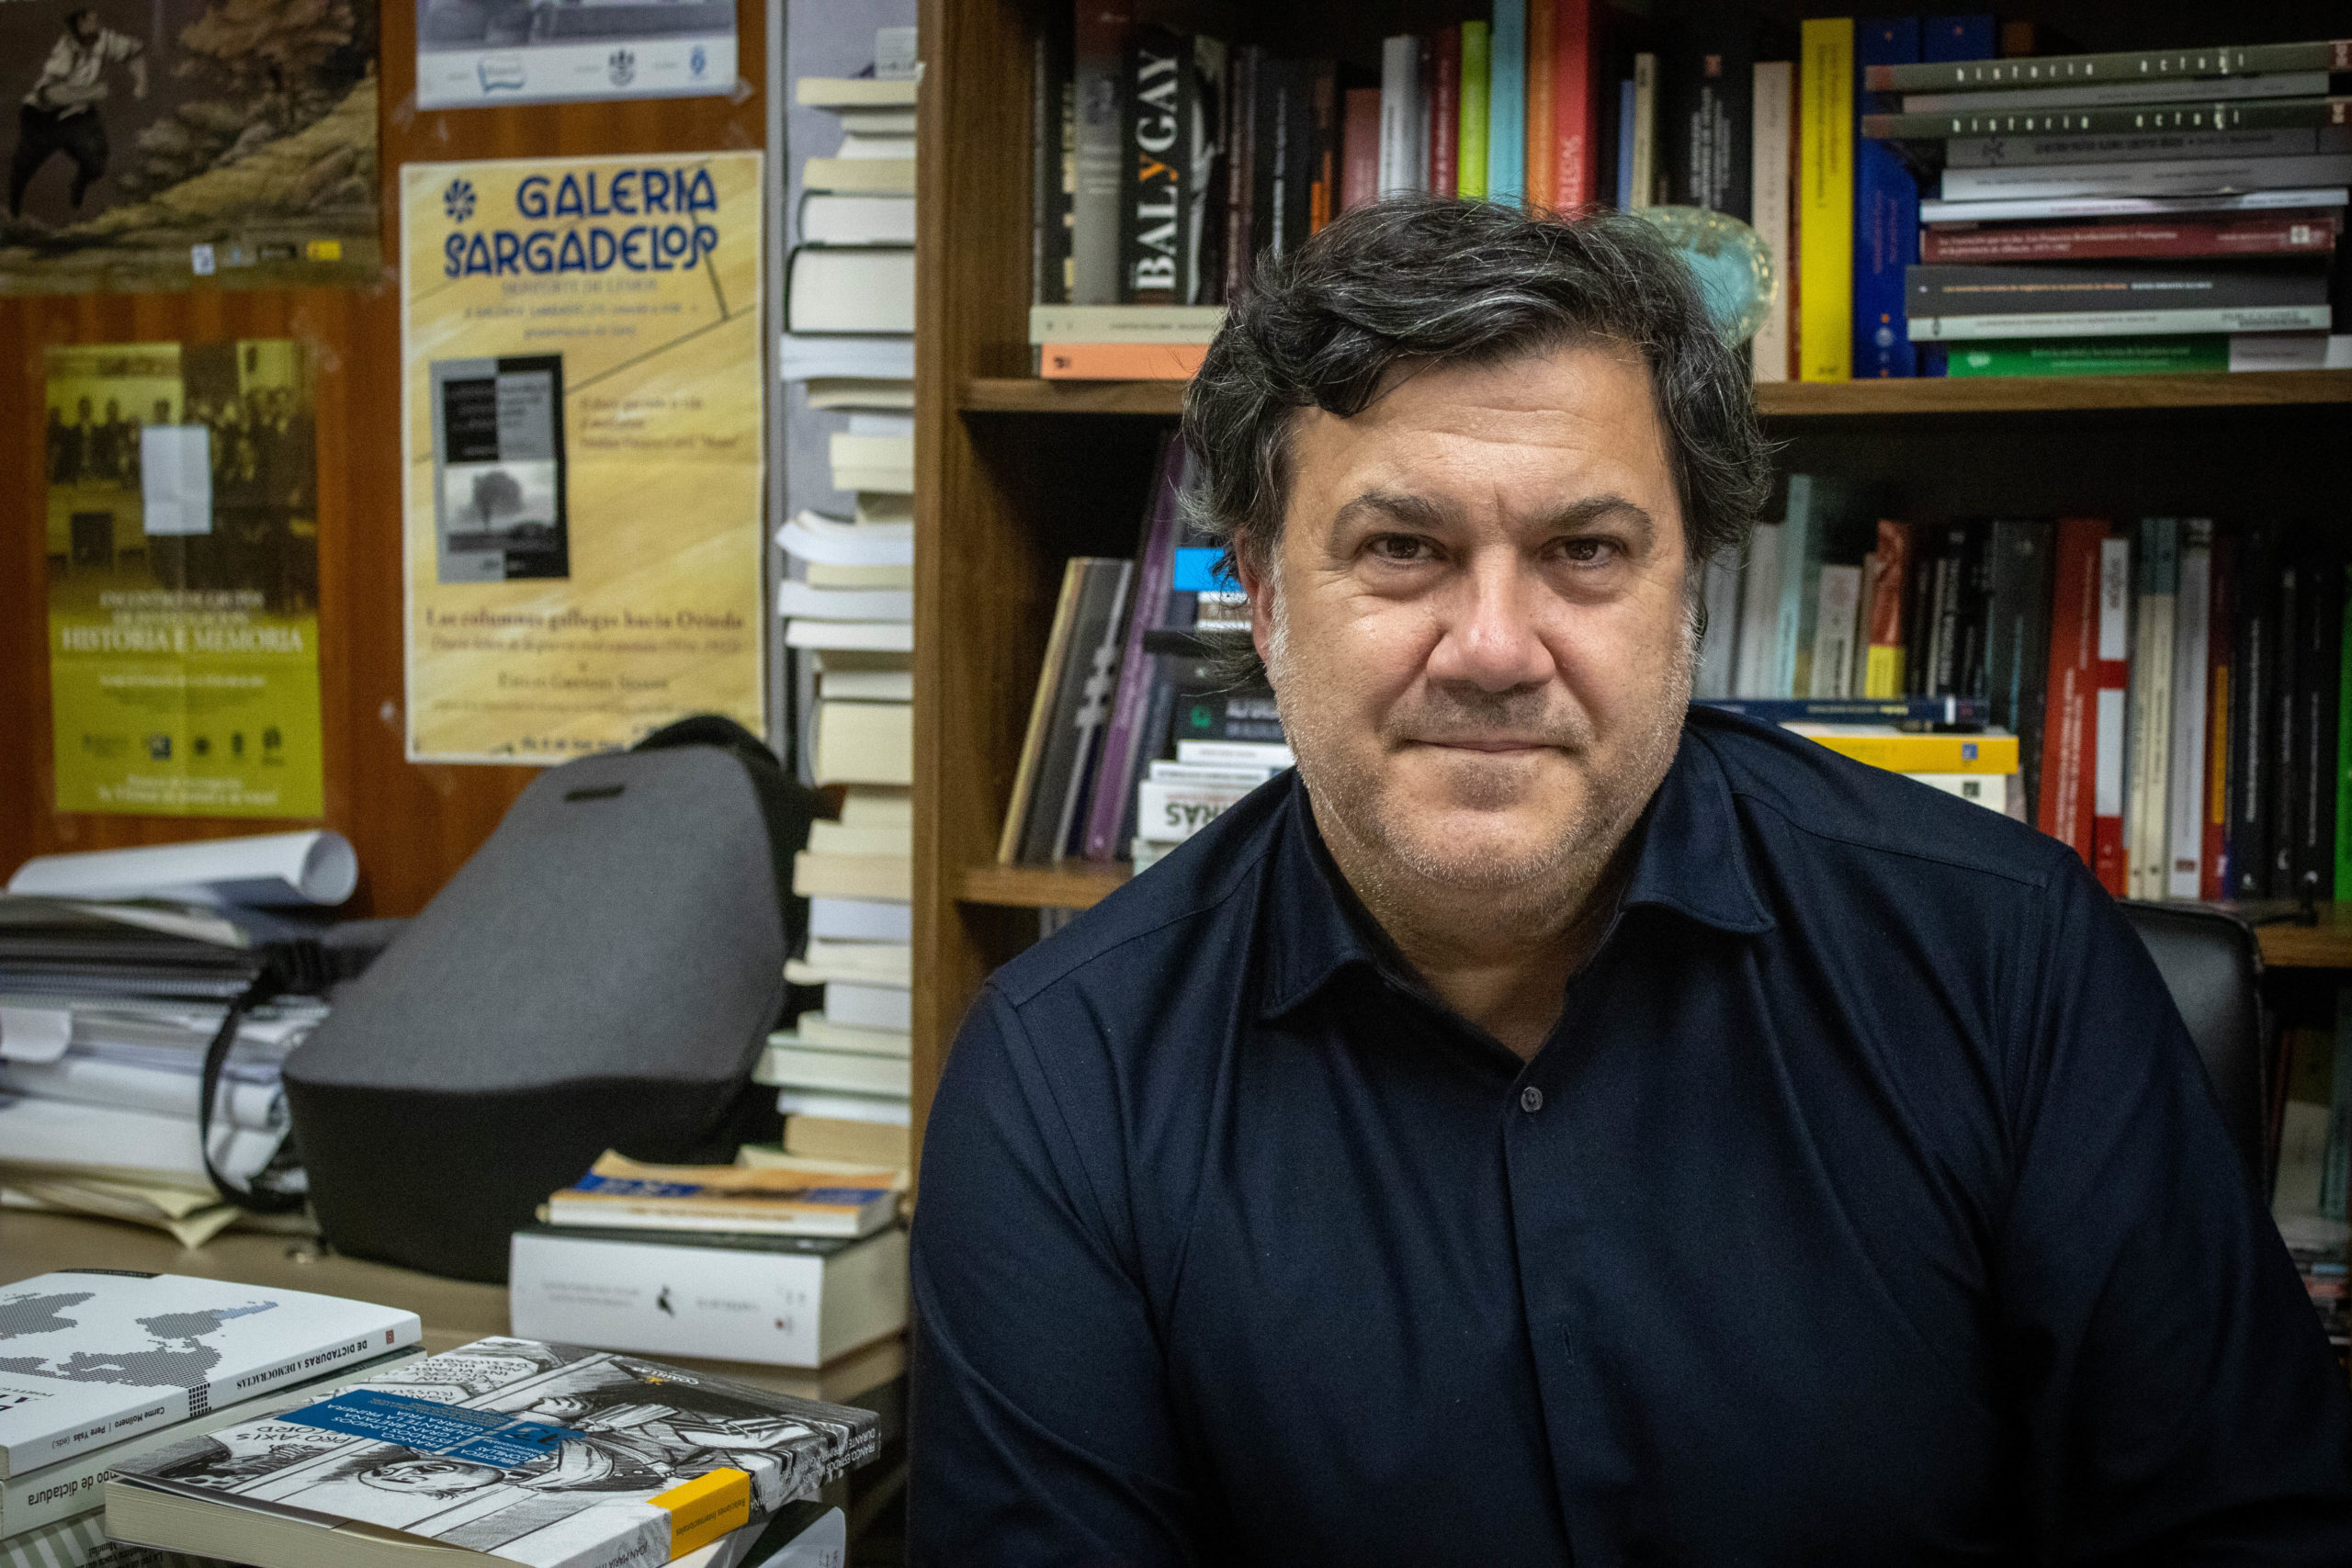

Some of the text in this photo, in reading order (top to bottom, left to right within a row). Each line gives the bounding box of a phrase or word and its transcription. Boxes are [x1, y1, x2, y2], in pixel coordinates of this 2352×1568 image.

[516, 168, 718, 220] GALERIA
[444, 223, 719, 279] SARGADELOS
[237, 1339, 368, 1389] DE DICTADURAS A DEMOCRACIAS
[144, 1407, 164, 1417] Carme
[328, 1404, 383, 1419] PRIMERA
[115, 1414, 142, 1427] Molinero
[404, 1419, 474, 1436] DURANTE
[429, 1417, 483, 1431] GUERRA
[91, 1426, 105, 1435] Pere
[332, 1417, 453, 1444] ESTADOS UNIDOS
[407, 1427, 449, 1437] GRAN
[236, 1433, 352, 1445] PRO-AXIS
[82, 1476, 93, 1490] de
[28, 1481, 77, 1506] dictadura
